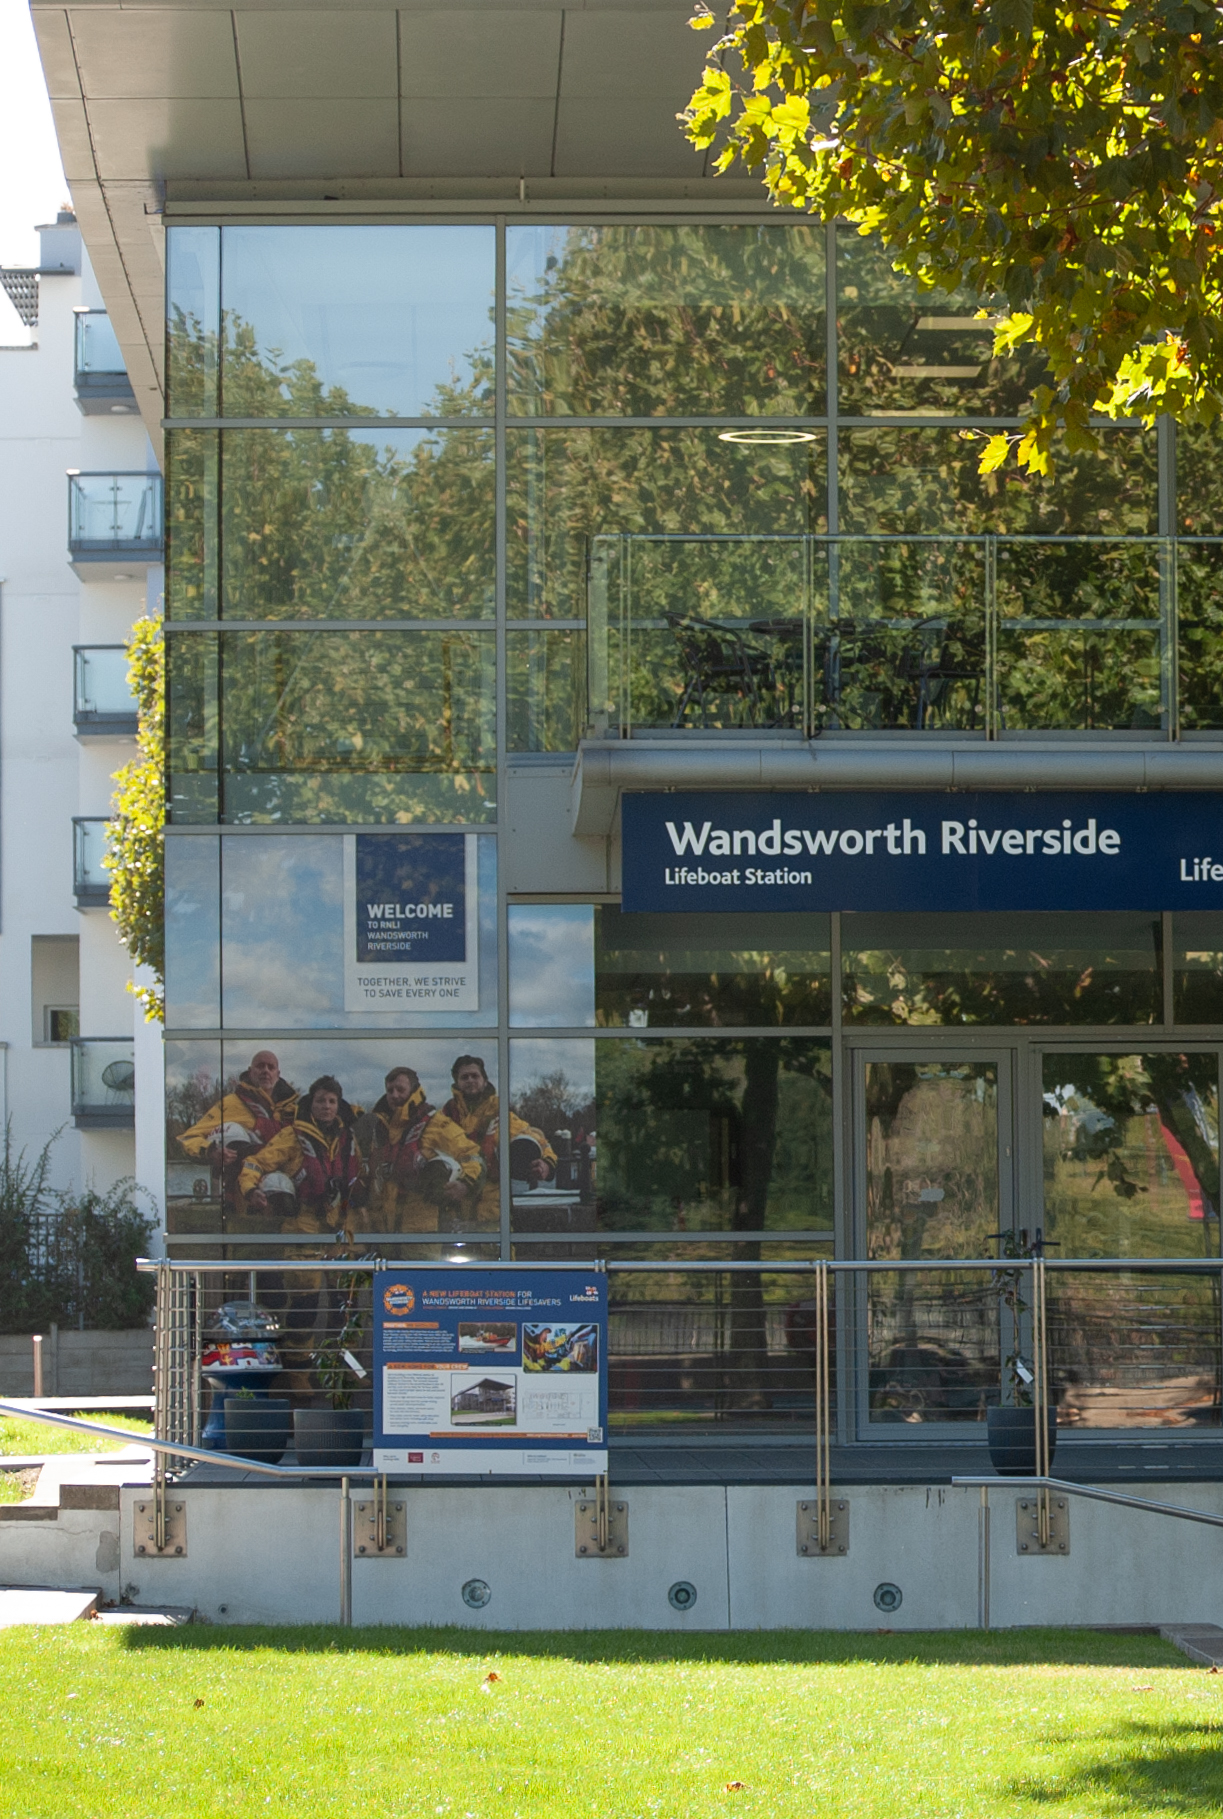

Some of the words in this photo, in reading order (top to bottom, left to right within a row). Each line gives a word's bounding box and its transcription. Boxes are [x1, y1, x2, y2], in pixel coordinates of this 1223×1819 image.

[665, 819, 927, 856] Wandsworth
[941, 818, 1121, 855] Riverside
[664, 867, 741, 885] Lifeboat
[745, 867, 812, 885] Station
[367, 903, 454, 918] WELCOME
[367, 921, 379, 929] TO
[380, 921, 400, 929] RNLI
[367, 931, 429, 940] WANDSWORTH
[367, 941, 412, 951] RIVERSIDE
[358, 977, 412, 988] TOGETHER,
[414, 977, 430, 987] WE
[432, 977, 467, 987] STRIVE
[364, 988, 376, 998] TO
[378, 988, 403, 998] SAVE
[406, 988, 437, 998] EVERY
[438, 988, 460, 998] ONE
[485, 1290, 516, 1298] STATION
[517, 1291, 533, 1299] FOR
[569, 1294, 599, 1302] Lifeboats
[422, 1298, 476, 1306] WANDSWORTH
[477, 1298, 516, 1306] RIVERSIDE
[517, 1298, 562, 1306] LIFESAVERS
